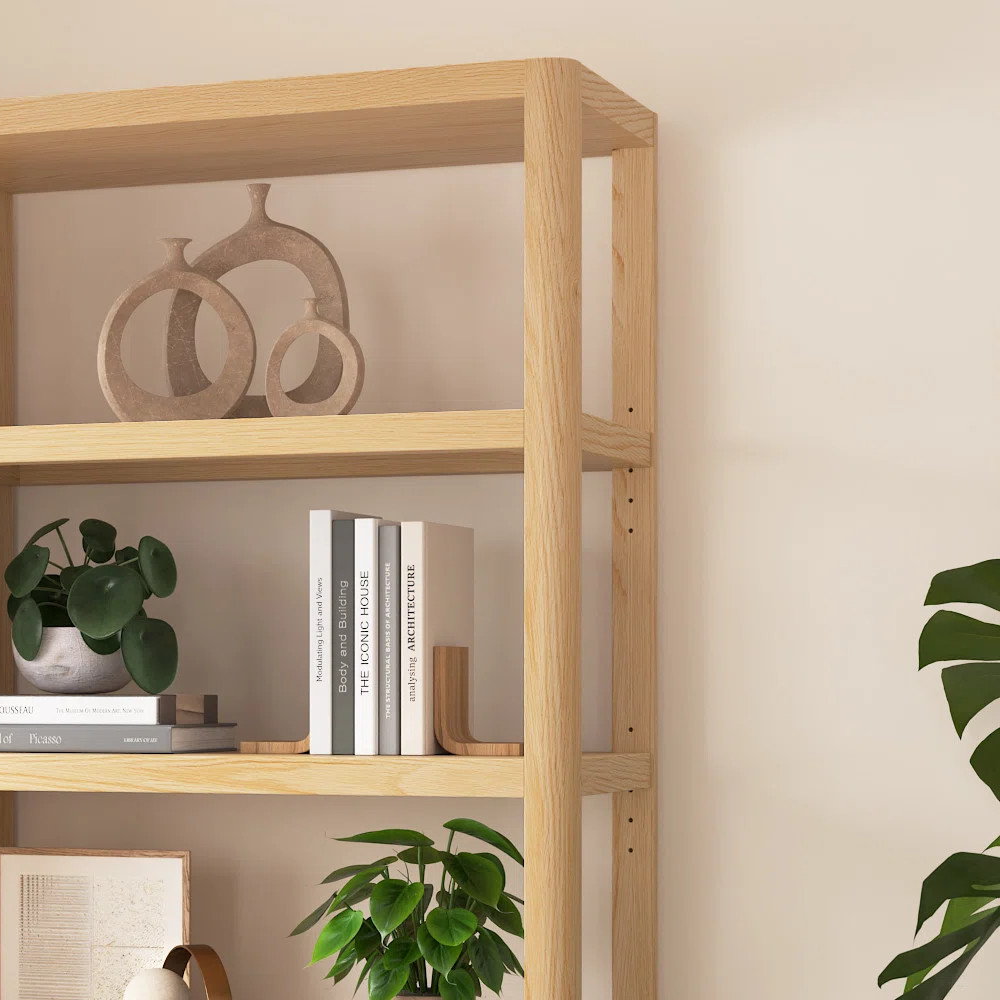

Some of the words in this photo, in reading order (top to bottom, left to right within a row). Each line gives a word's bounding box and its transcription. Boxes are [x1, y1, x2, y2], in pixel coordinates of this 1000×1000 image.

[338, 580, 349, 629] Building
[360, 570, 369, 616] HOUSE
[407, 564, 415, 652] ARCHITECTURE
[316, 618, 325, 638] Light
[385, 619, 391, 630] OF
[338, 634, 347, 657] and
[360, 621, 369, 665] ICONIC
[316, 639, 325, 682] Modulating
[338, 661, 349, 693] Body
[360, 671, 369, 696] THE
[407, 657, 418, 702] analysing
[3, 732, 14, 744] of
[29, 732, 62, 744] Picasso
